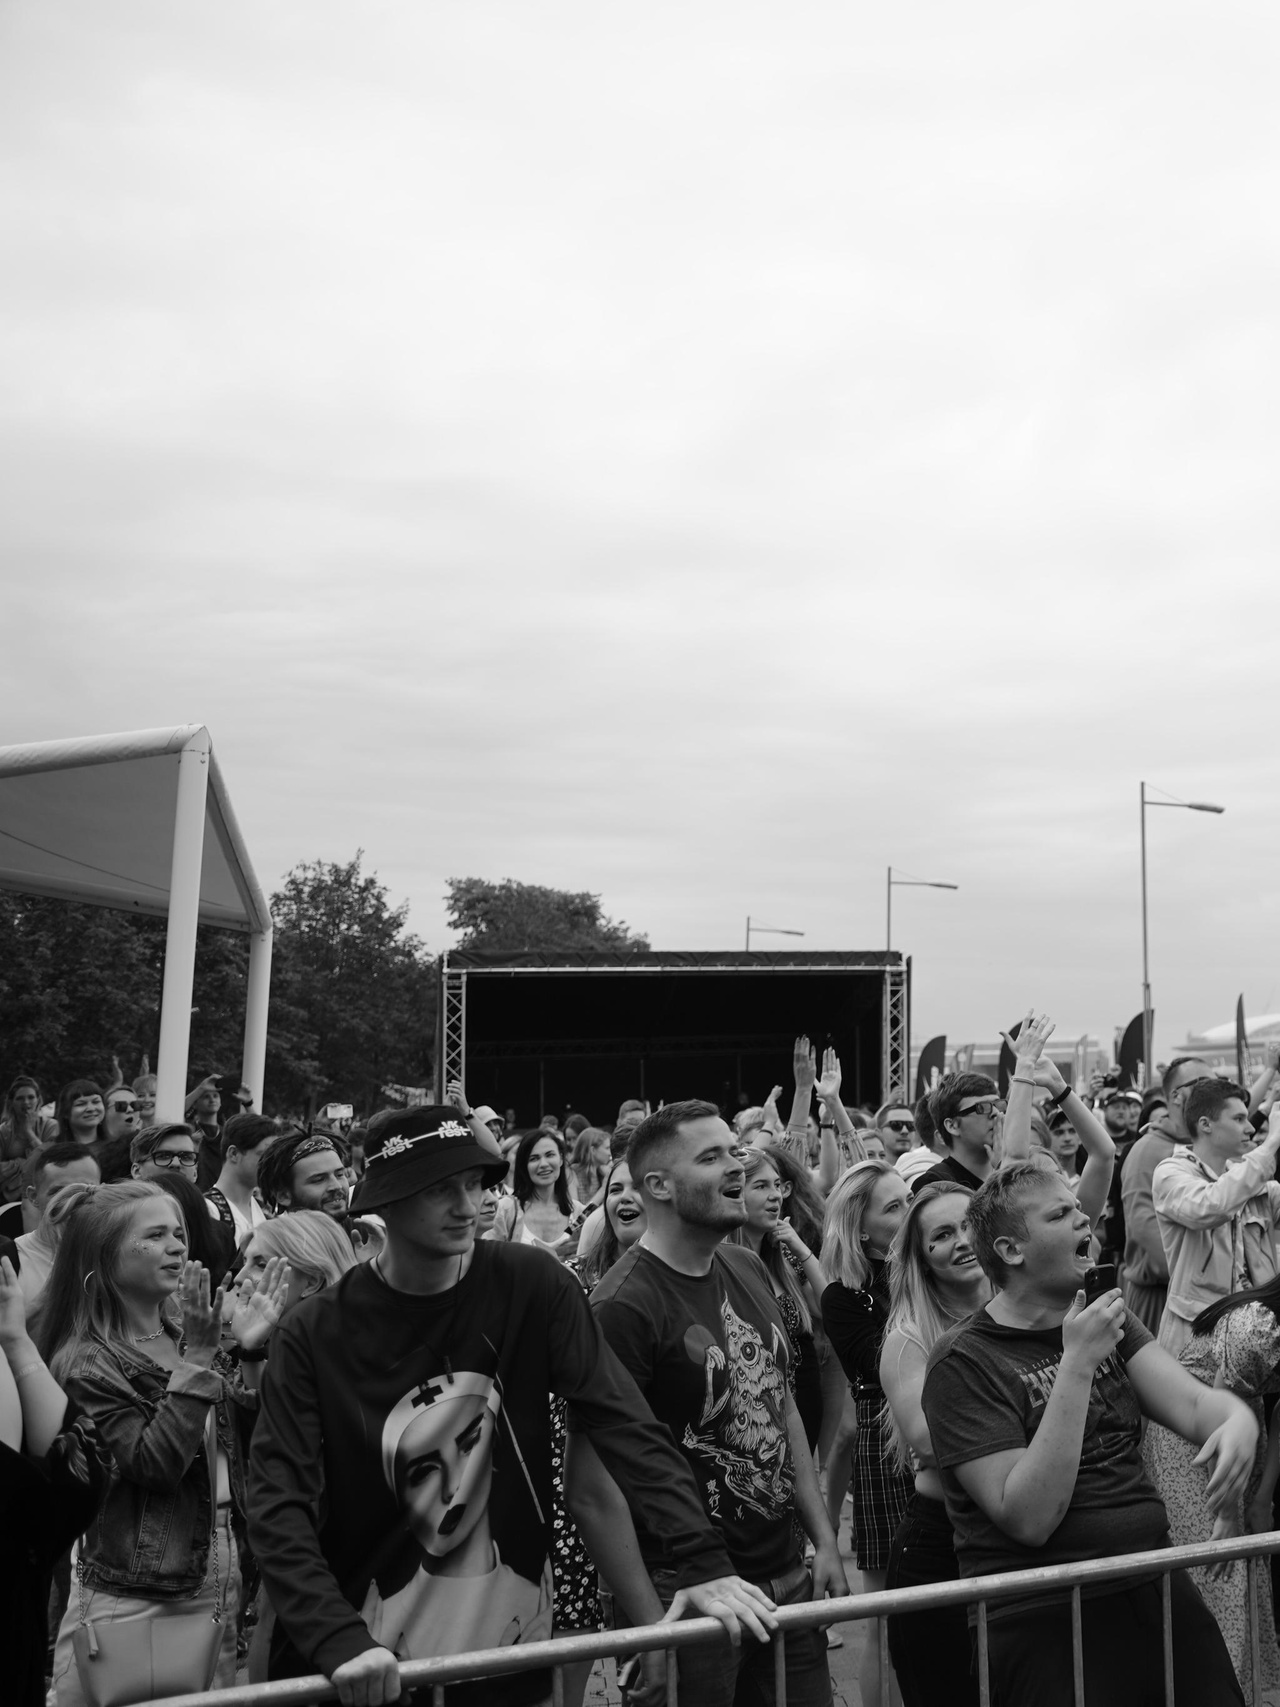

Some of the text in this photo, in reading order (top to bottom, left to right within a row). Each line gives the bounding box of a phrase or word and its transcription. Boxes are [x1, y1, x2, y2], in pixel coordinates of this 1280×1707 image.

[441, 1120, 459, 1129] VK
[438, 1126, 468, 1139] fest
[384, 1134, 402, 1148] VK
[381, 1138, 413, 1159] fest
